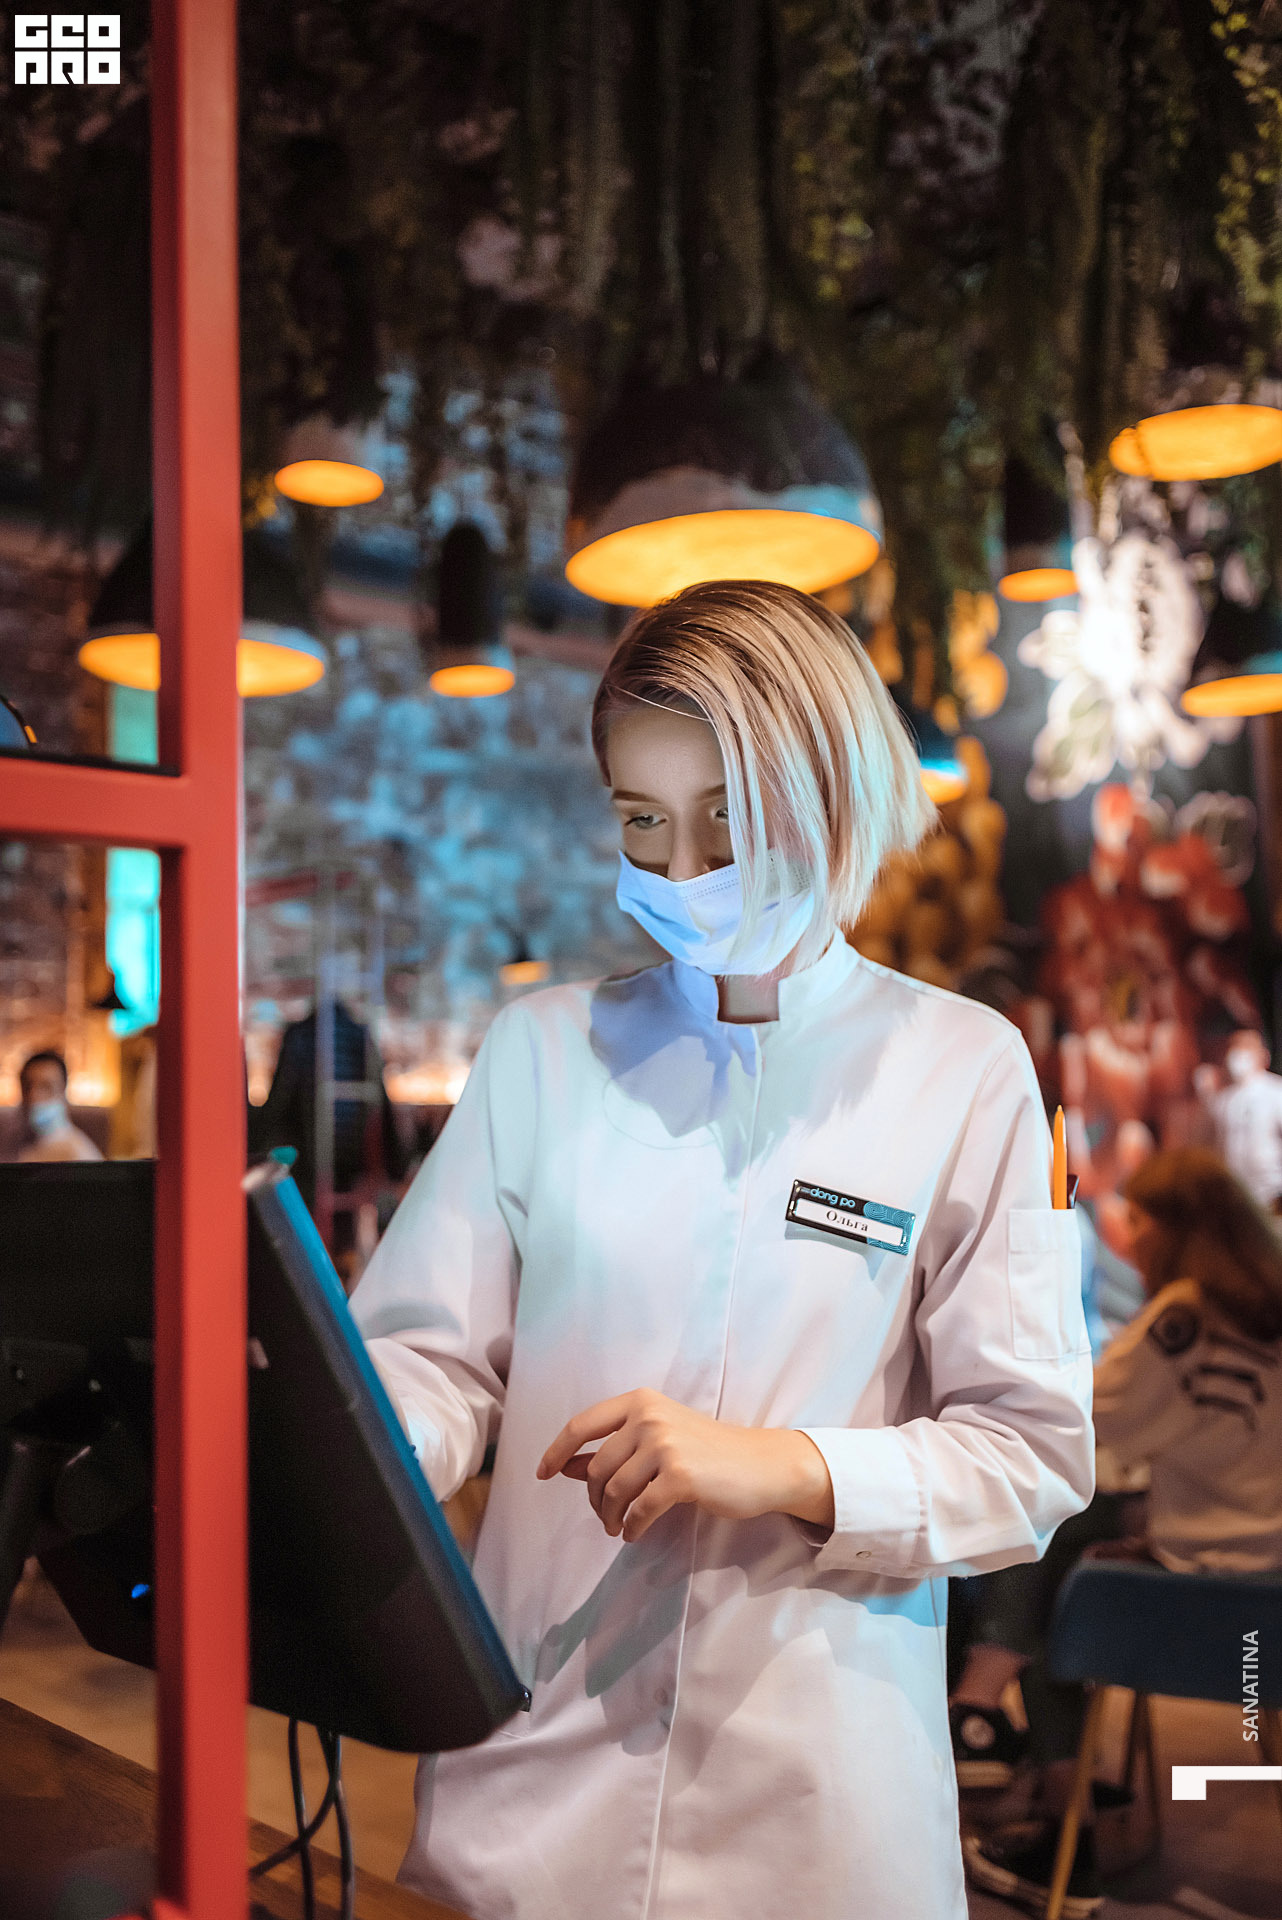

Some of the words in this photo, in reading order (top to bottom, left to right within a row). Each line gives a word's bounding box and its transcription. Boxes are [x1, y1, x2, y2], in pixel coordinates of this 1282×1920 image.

[810, 1188, 838, 1204] dong
[840, 1197, 855, 1208] po
[826, 1210, 868, 1232] Ольга
